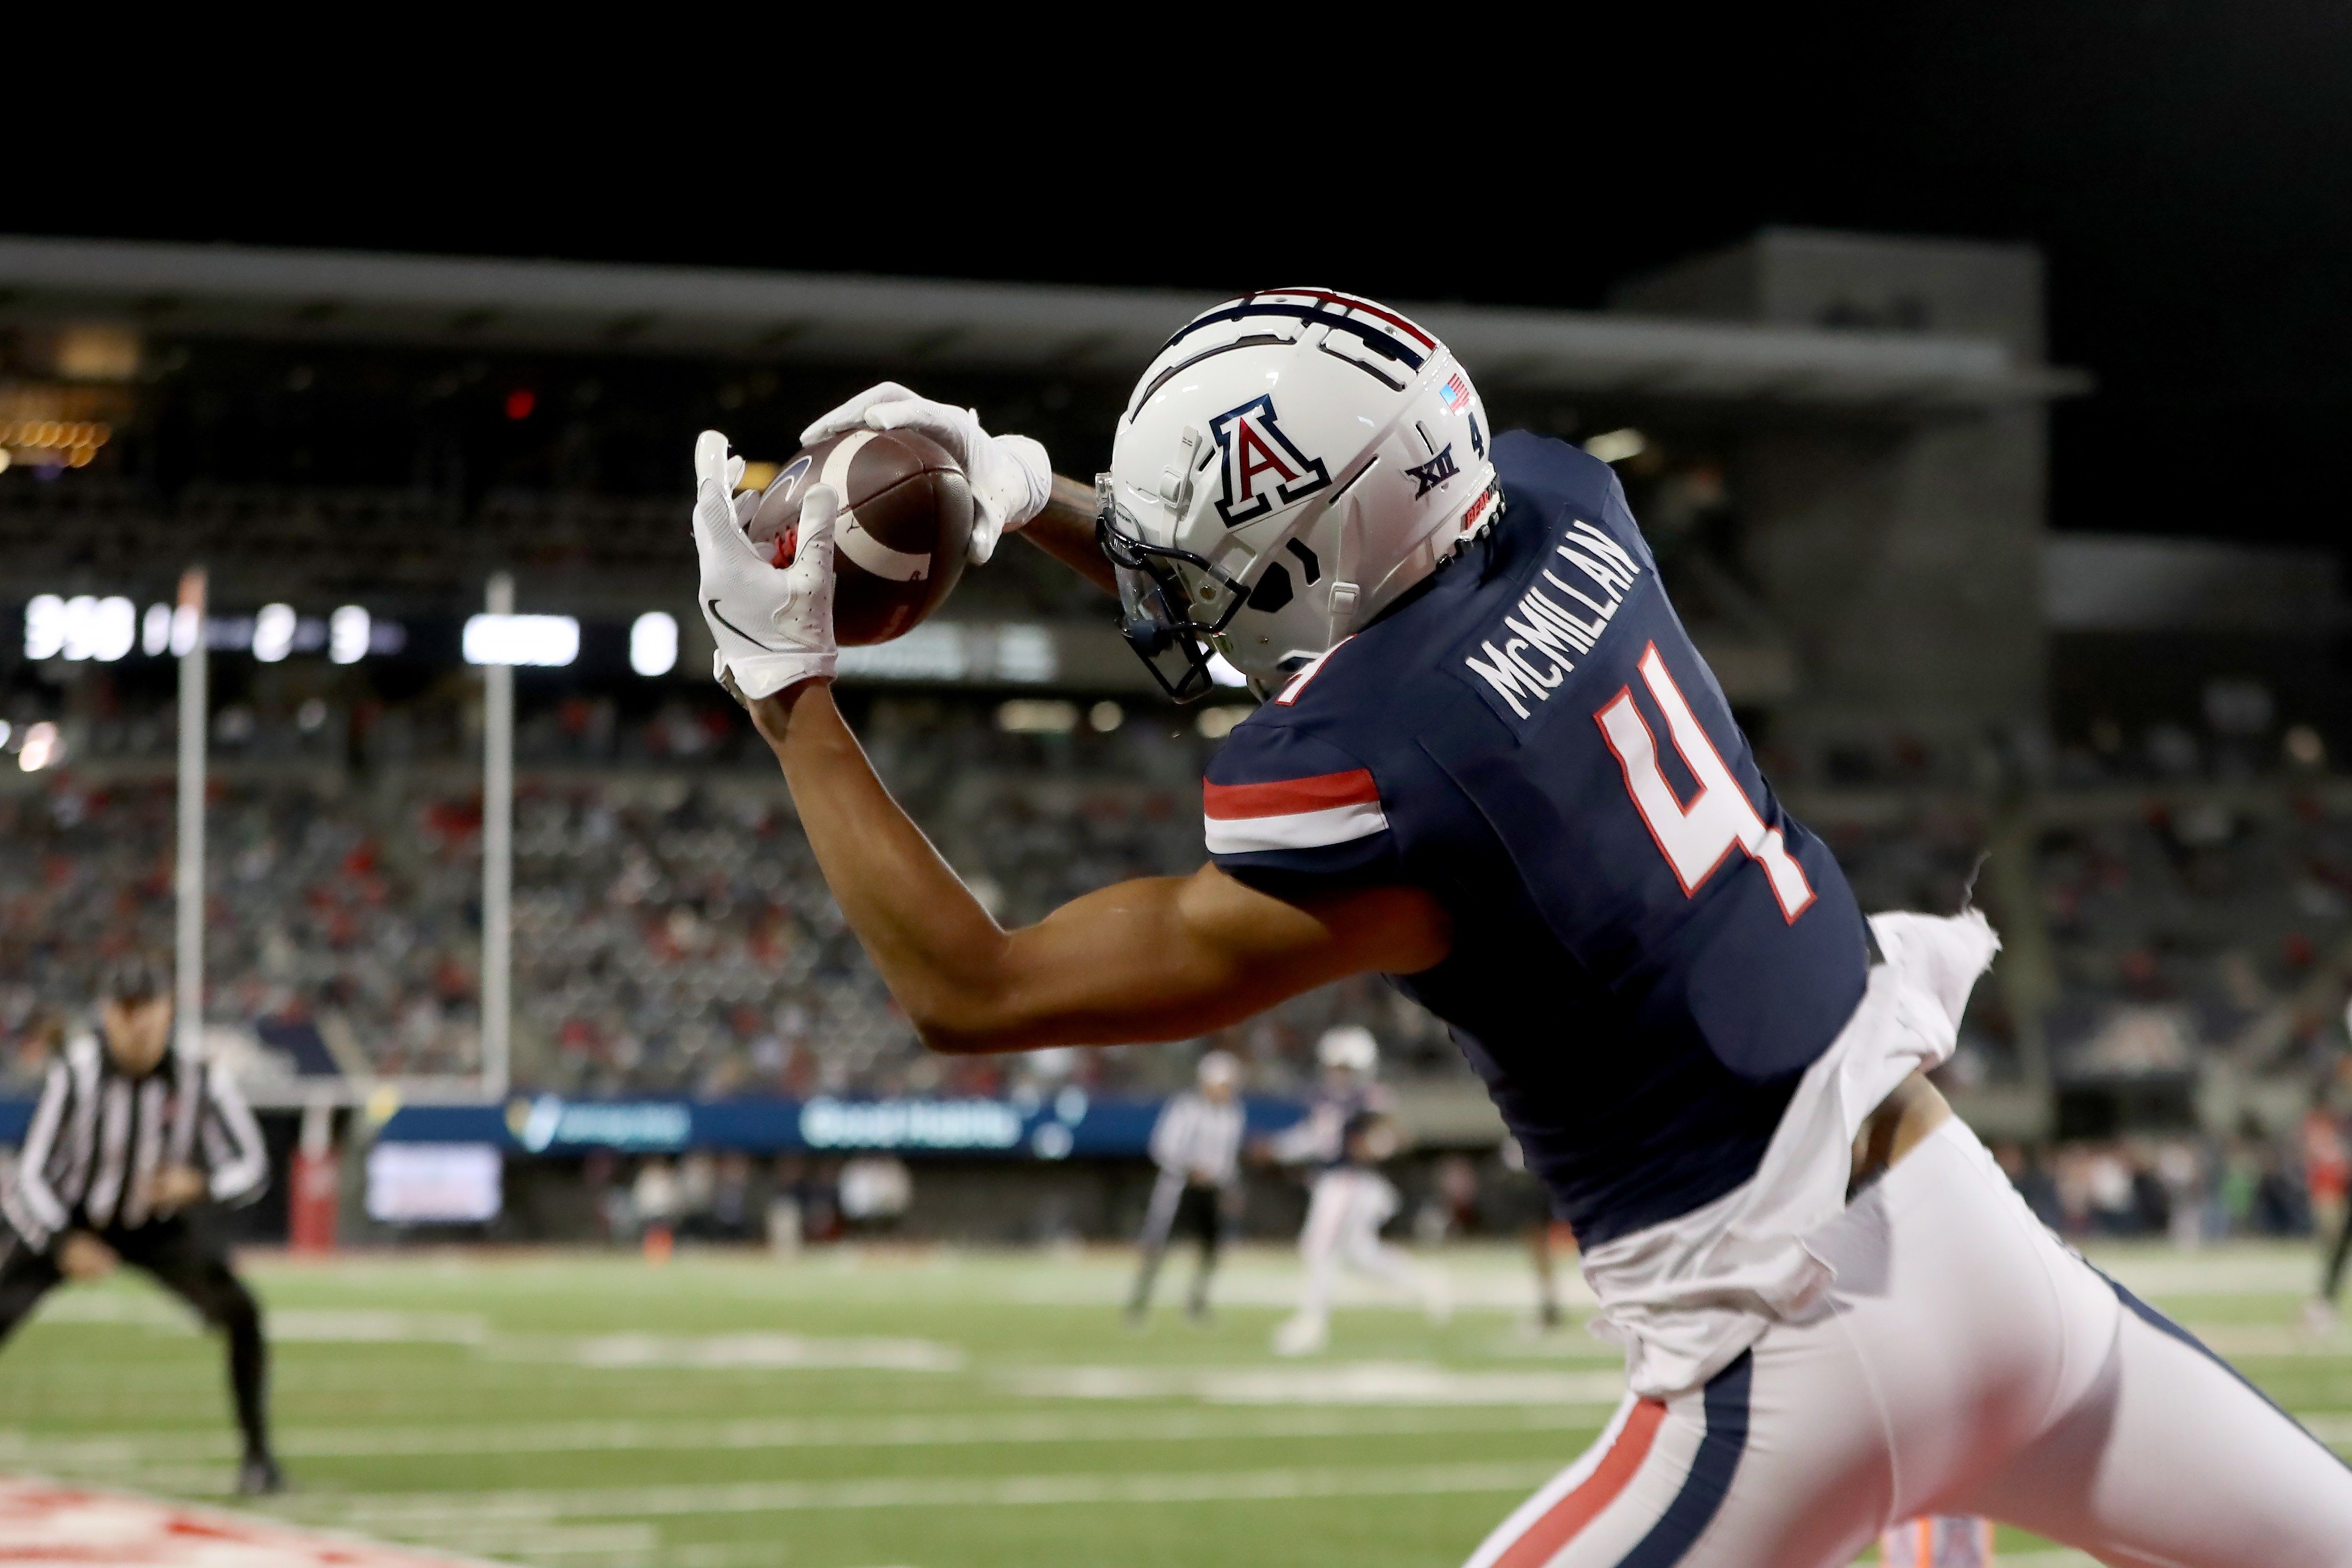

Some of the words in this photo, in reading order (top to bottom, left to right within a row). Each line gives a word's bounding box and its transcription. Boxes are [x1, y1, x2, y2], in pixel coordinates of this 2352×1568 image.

[1209, 393, 1333, 529] A
[1405, 442, 1460, 502] XII
[1468, 411, 1485, 461] 4
[1593, 639, 1818, 926] 4
